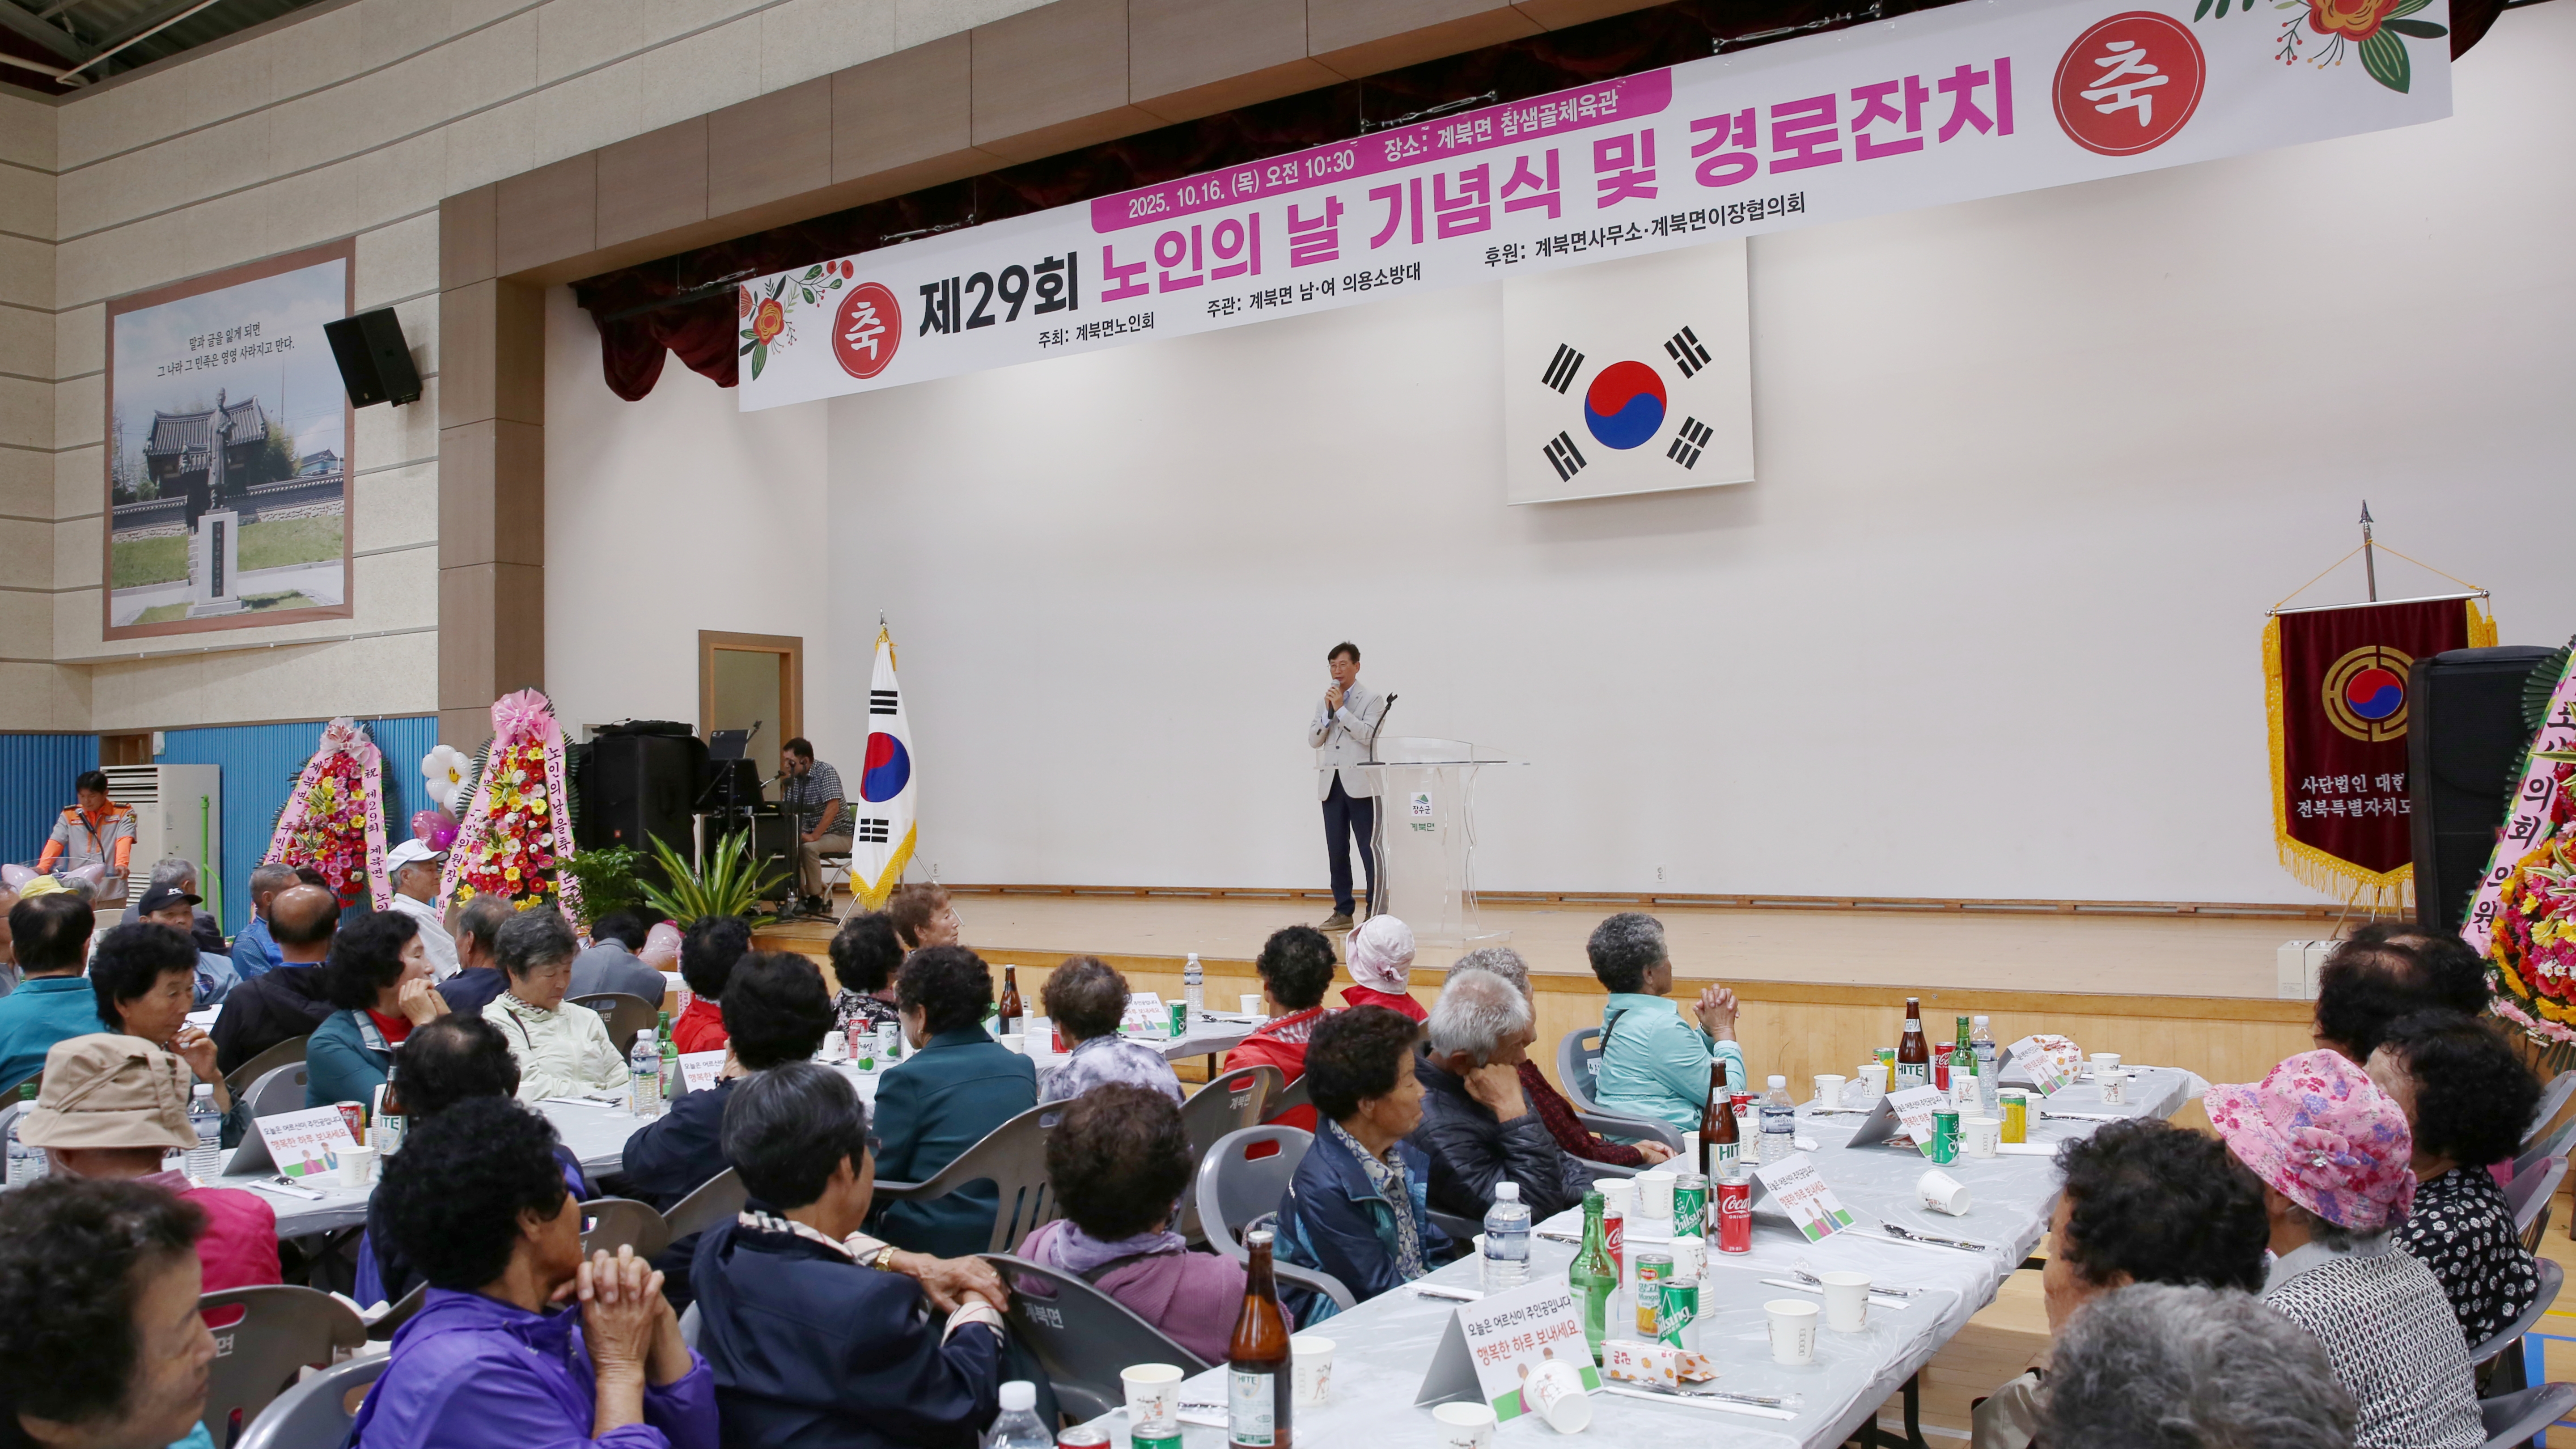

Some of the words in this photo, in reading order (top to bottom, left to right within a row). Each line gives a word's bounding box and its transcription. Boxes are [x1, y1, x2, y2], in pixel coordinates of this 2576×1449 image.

[2080, 40, 2169, 128] 축
[1384, 133, 1428, 163] 장소:
[1436, 116, 1492, 150] 계북면
[1500, 88, 1619, 136] 참샘골체육관
[1101, 212, 1262, 304] 노인의
[1287, 195, 1344, 268] 날
[1368, 148, 1562, 250] 기념식
[1593, 128, 1659, 210] 및
[1689, 55, 2015, 188] 경로잔치
[1128, 191, 1170, 220] 2025.
[1177, 180, 1225, 207] 10.16.
[1231, 169, 1260, 199] (목)
[1265, 162, 1300, 187] 오전
[1305, 149, 1355, 179] 10:30
[1484, 241, 1525, 268] 후원:
[919, 251, 1079, 338] 제29회
[1207, 295, 1242, 318] 주관:
[1249, 285, 1292, 311] 계북면
[1300, 276, 1336, 301] 남·여
[1342, 261, 1422, 293] 의용소방대
[189, 335, 205, 352] 말과
[207, 331, 224, 348] 글을
[244, 322, 261, 336] 되면
[845, 301, 886, 361] 축
[1038, 328, 1069, 349] 주최:
[1076, 311, 1155, 342] 계북면노인회
[157, 366, 165, 377] 그
[167, 360, 183, 376] 나라
[184, 359, 194, 371] 그
[195, 353, 219, 370] 민족은
[221, 348, 237, 365] 영영
[239, 342, 273, 360] 사라지고
[275, 335, 295, 353] 만다.
[364, 767, 379, 779] 祝
[2301, 774, 2368, 795] 사단법인
[365, 788, 379, 834] 제29회
[1412, 805, 1431, 814] 장수군
[1410, 823, 1435, 832] 계북면
[369, 844, 385, 879] 계북면
[688, 1072, 712, 1083] 행복한
[1898, 1064, 1923, 1077] HITE
[1229, 1092, 1252, 1110] 계북면
[263, 1124, 283, 1135] 오늘은
[380, 1117, 399, 1131] ITE
[270, 1136, 297, 1151] 행복한
[297, 1133, 314, 1145] 하루
[1719, 1144, 1740, 1162] HIT
[1638, 1282, 1659, 1293] 망고
[1022, 1302, 1064, 1329] 계북면
[1468, 1318, 1493, 1336] 오늘은
[1493, 1309, 1526, 1329] 어르신이
[1477, 1339, 1512, 1366] 행복한
[1512, 1332, 1535, 1352] 하루
[1536, 1319, 1583, 1345] 보내세요.
[1661, 1322, 1682, 1338] CIDER
